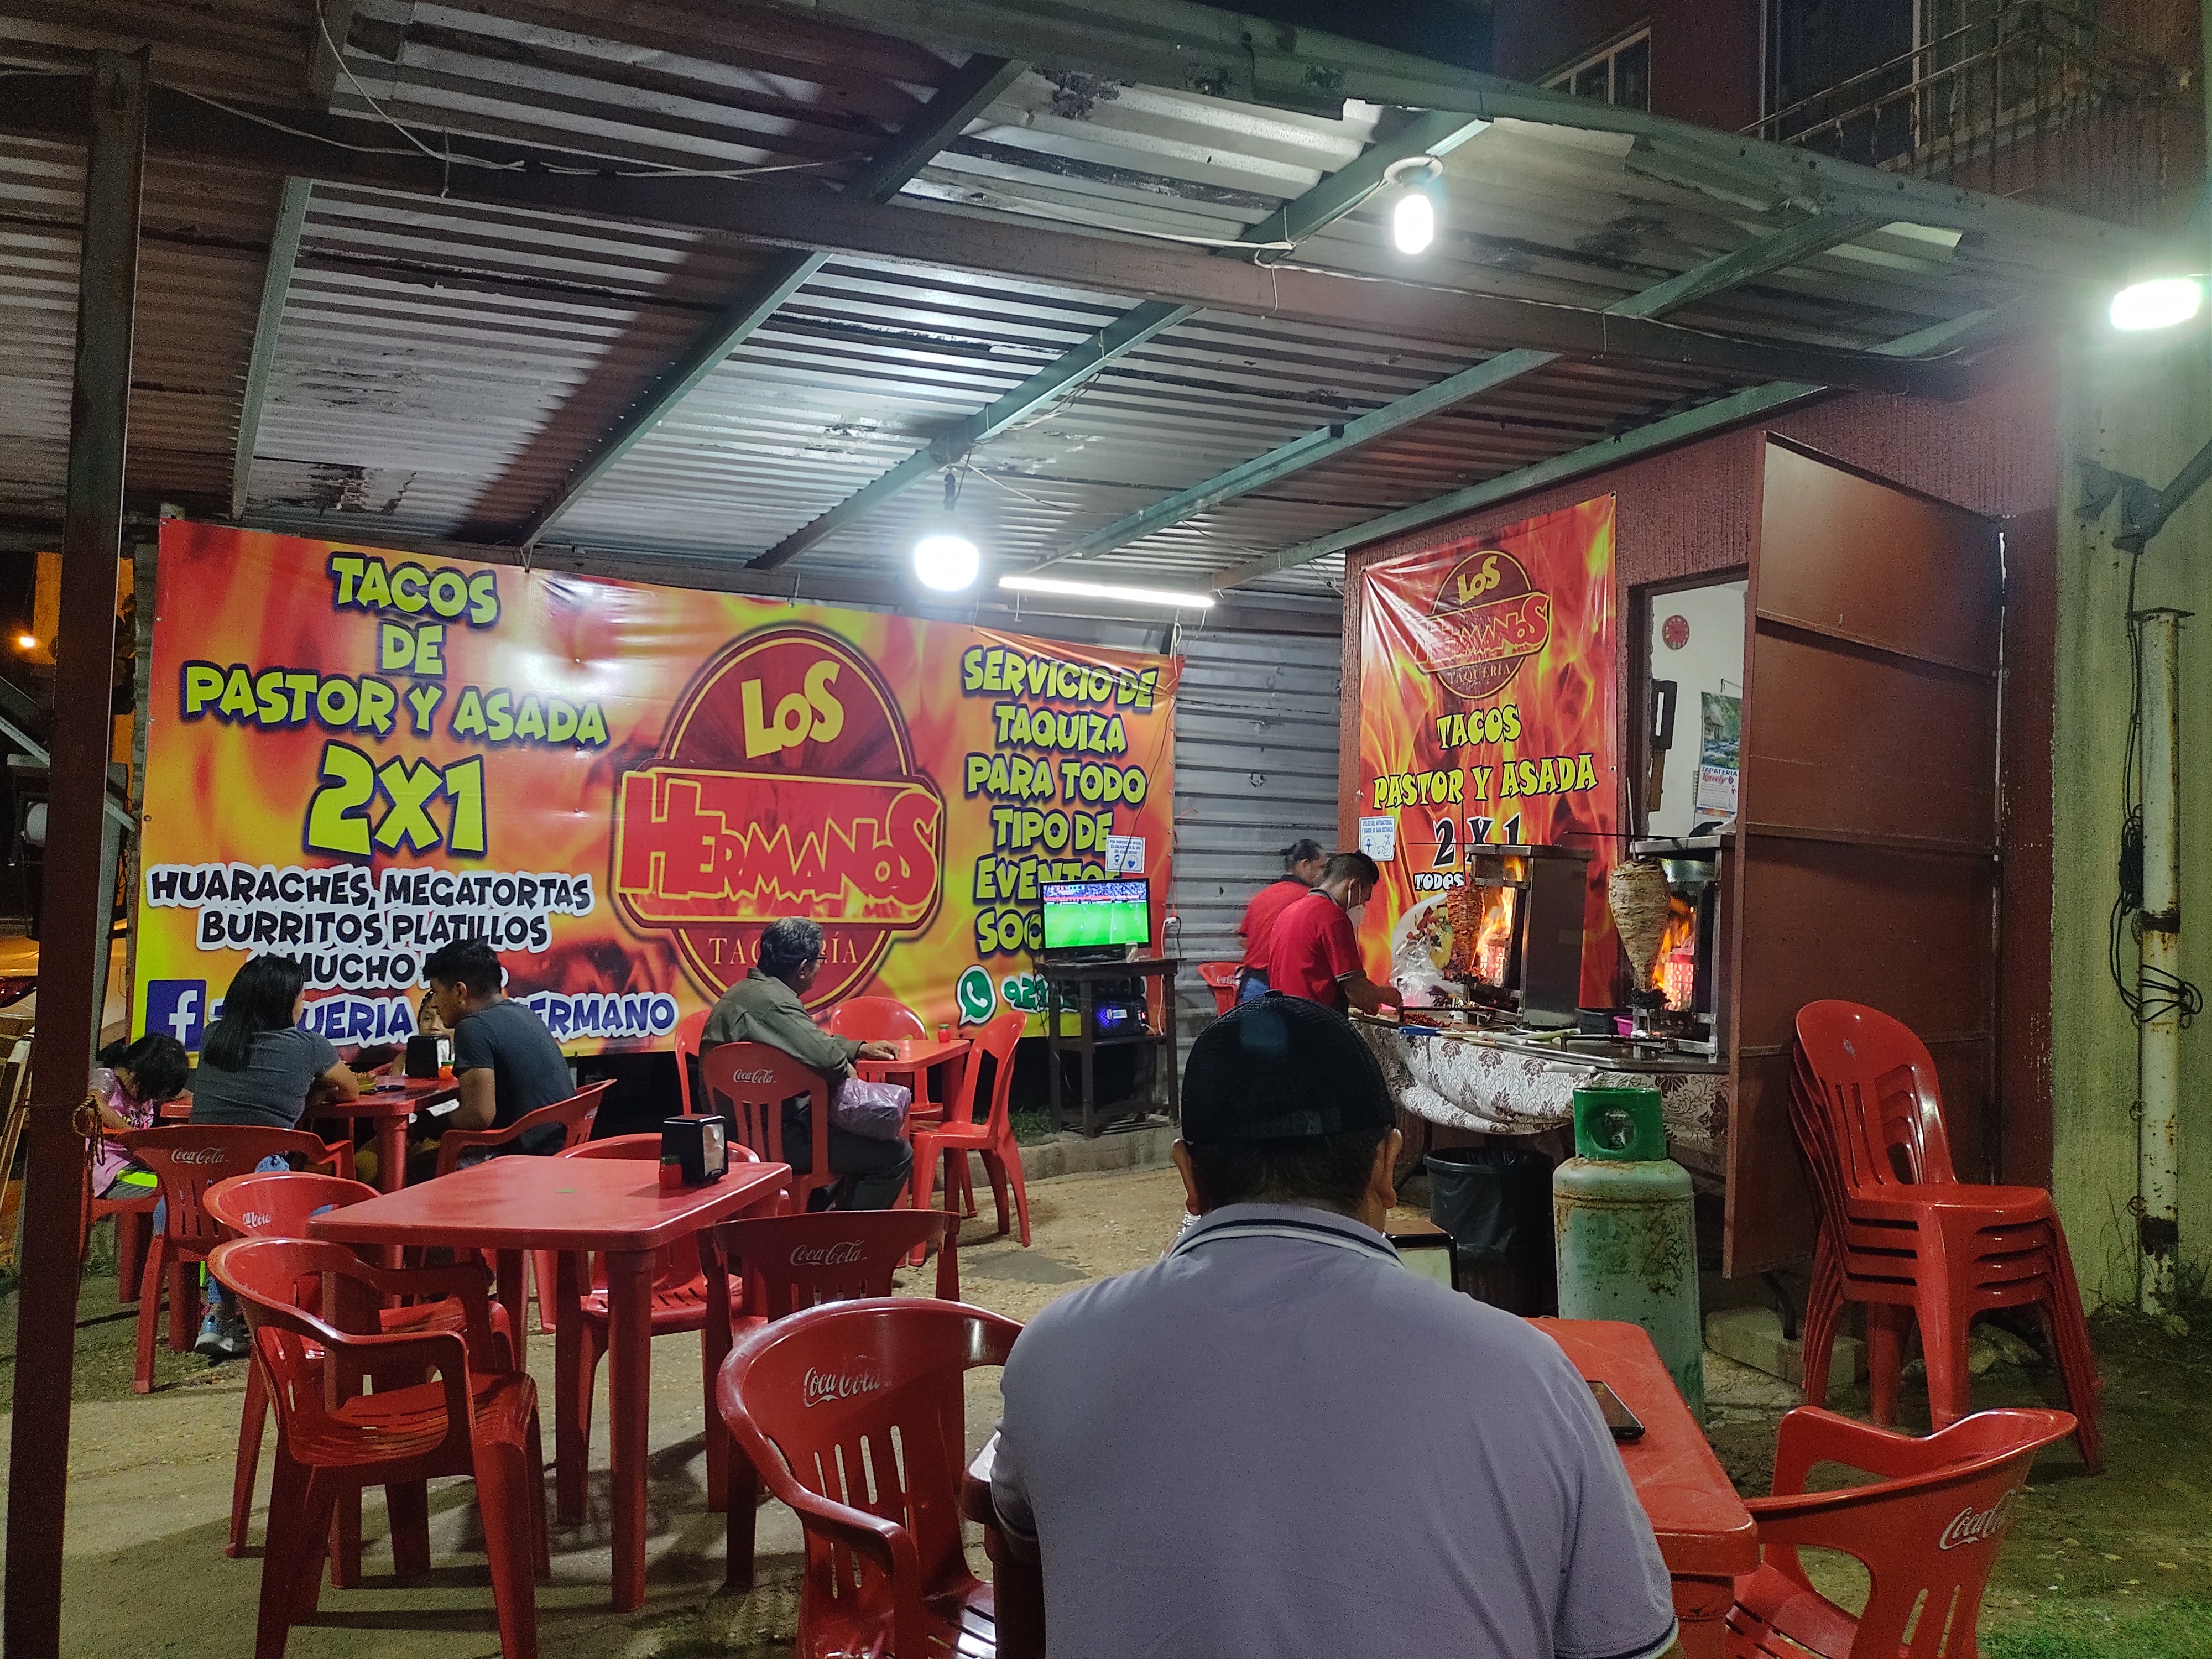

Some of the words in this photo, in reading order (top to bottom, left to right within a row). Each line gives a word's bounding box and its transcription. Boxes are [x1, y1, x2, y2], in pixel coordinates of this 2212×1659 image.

[332, 557, 498, 624] TACOS
[382, 623, 444, 675] DE
[964, 649, 1112, 703] SERVICIO
[1116, 670, 1157, 708] DE
[185, 665, 396, 734] PASTOR
[408, 687, 444, 732] Y
[453, 692, 607, 745] ASADA
[995, 705, 1126, 754] TAQUIZA
[1436, 705, 1521, 750] TACOS
[968, 755, 1054, 801] PARA
[1061, 761, 1146, 804] TODO
[1373, 768, 1464, 809] PASTOR
[1470, 766, 1493, 801] Y
[1499, 753, 1599, 798] ASADA
[1702, 766, 1738, 776] ZAPATERIA
[307, 744, 484, 857] 2X1
[993, 808, 1069, 849] TIPO
[1075, 812, 1113, 852] DE
[1432, 817, 1457, 869] 2
[152, 868, 376, 910] HUARACHES,
[387, 872, 591, 910] MEGATORTAS
[1414, 873, 1465, 890] TODOS
[202, 910, 383, 946] BURRITOS
[392, 912, 547, 947] PLATILLOS
